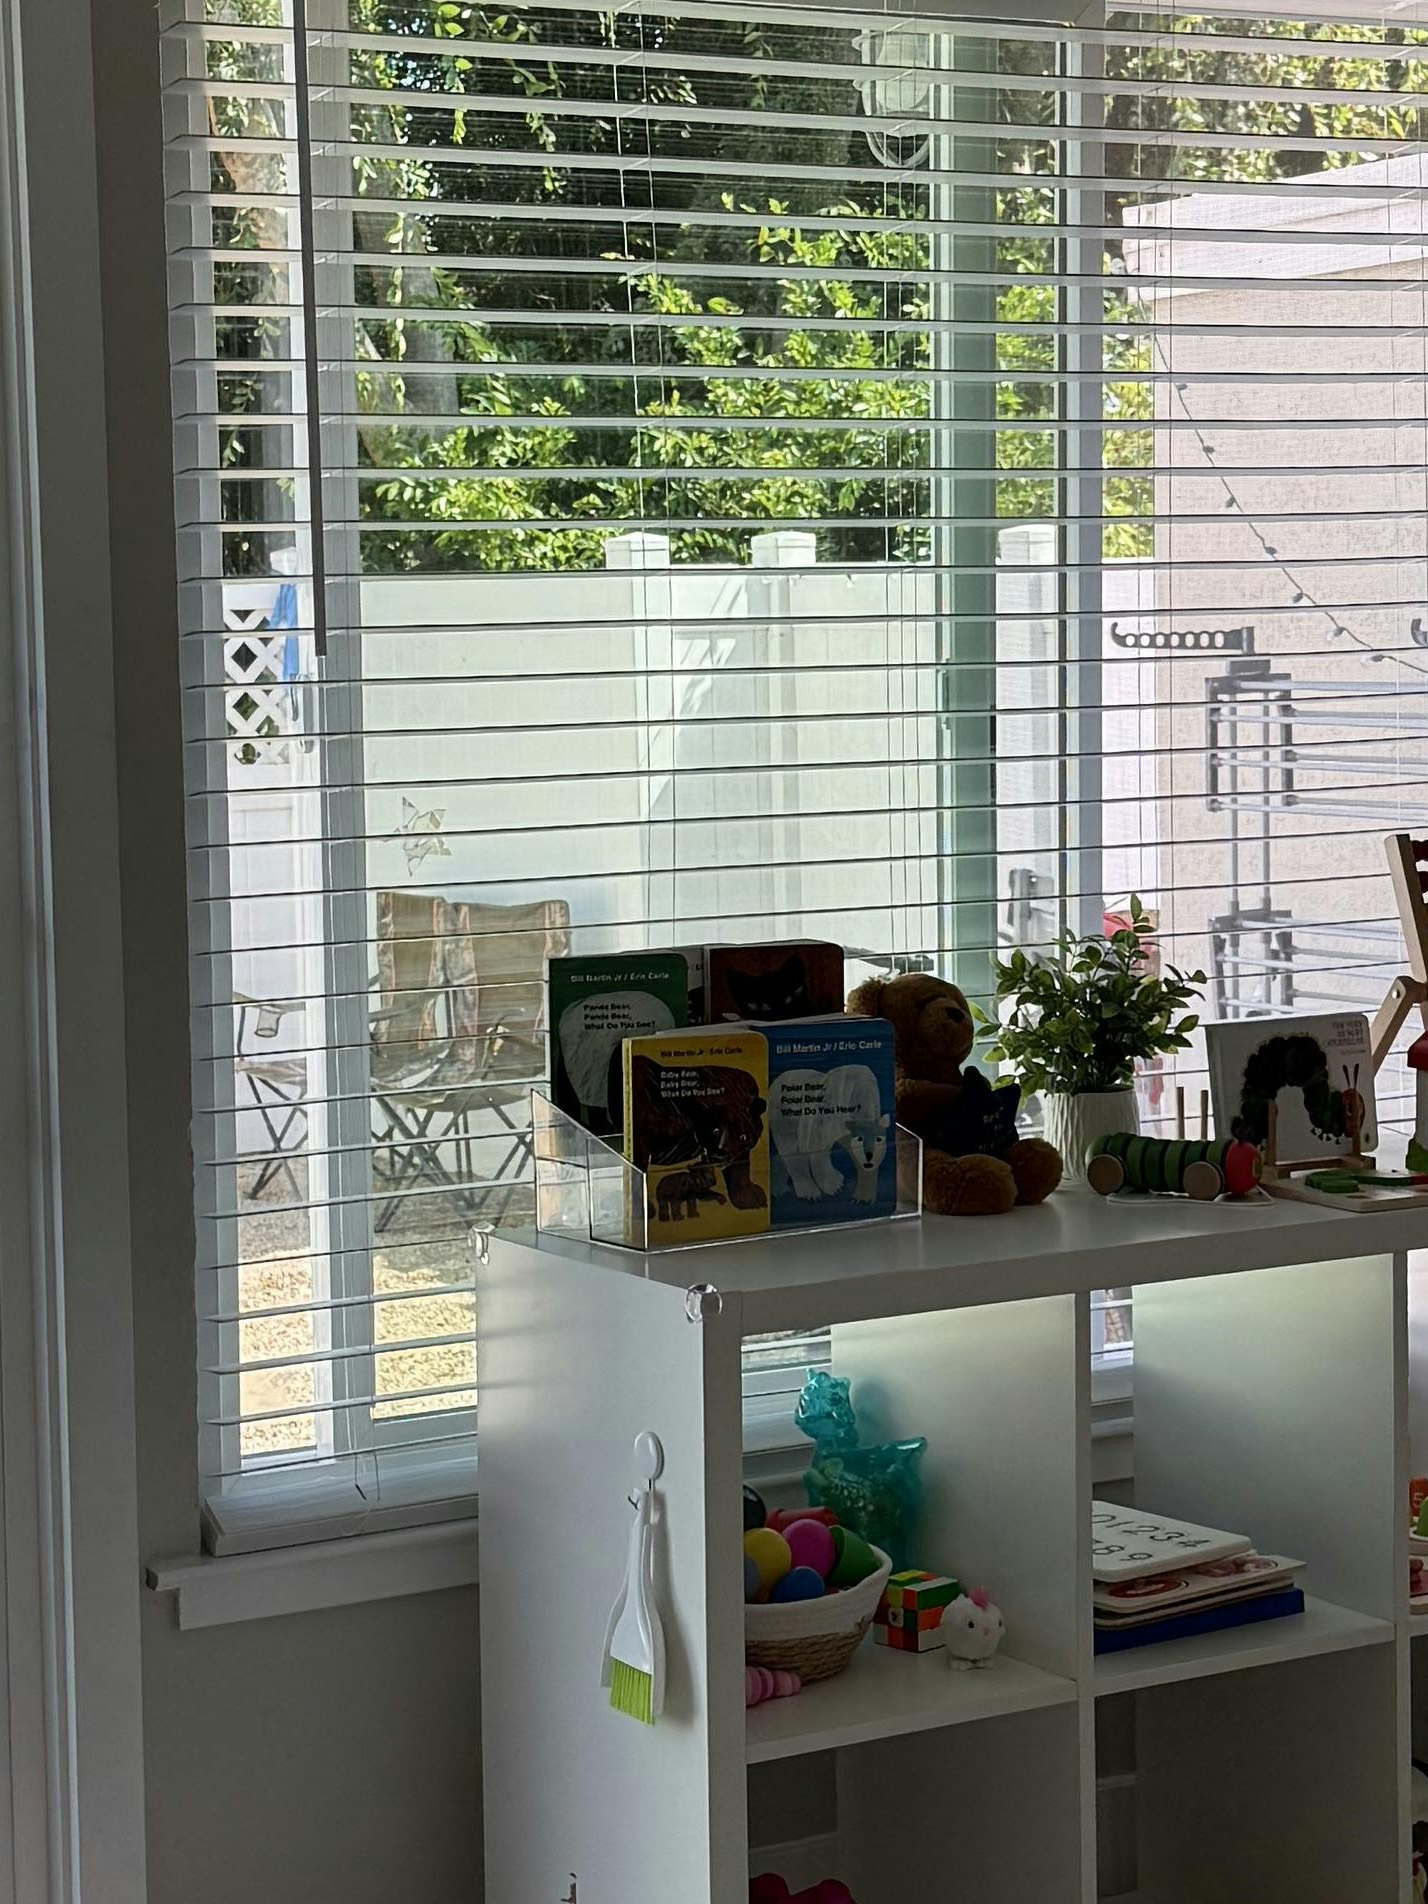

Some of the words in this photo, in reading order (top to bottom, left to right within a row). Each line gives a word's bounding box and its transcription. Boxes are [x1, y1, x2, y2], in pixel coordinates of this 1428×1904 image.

[792, 1043, 821, 1054] Martin
[822, 1042, 832, 1052] Jr
[838, 1041, 857, 1050] Eric
[858, 1039, 882, 1050] Carle
